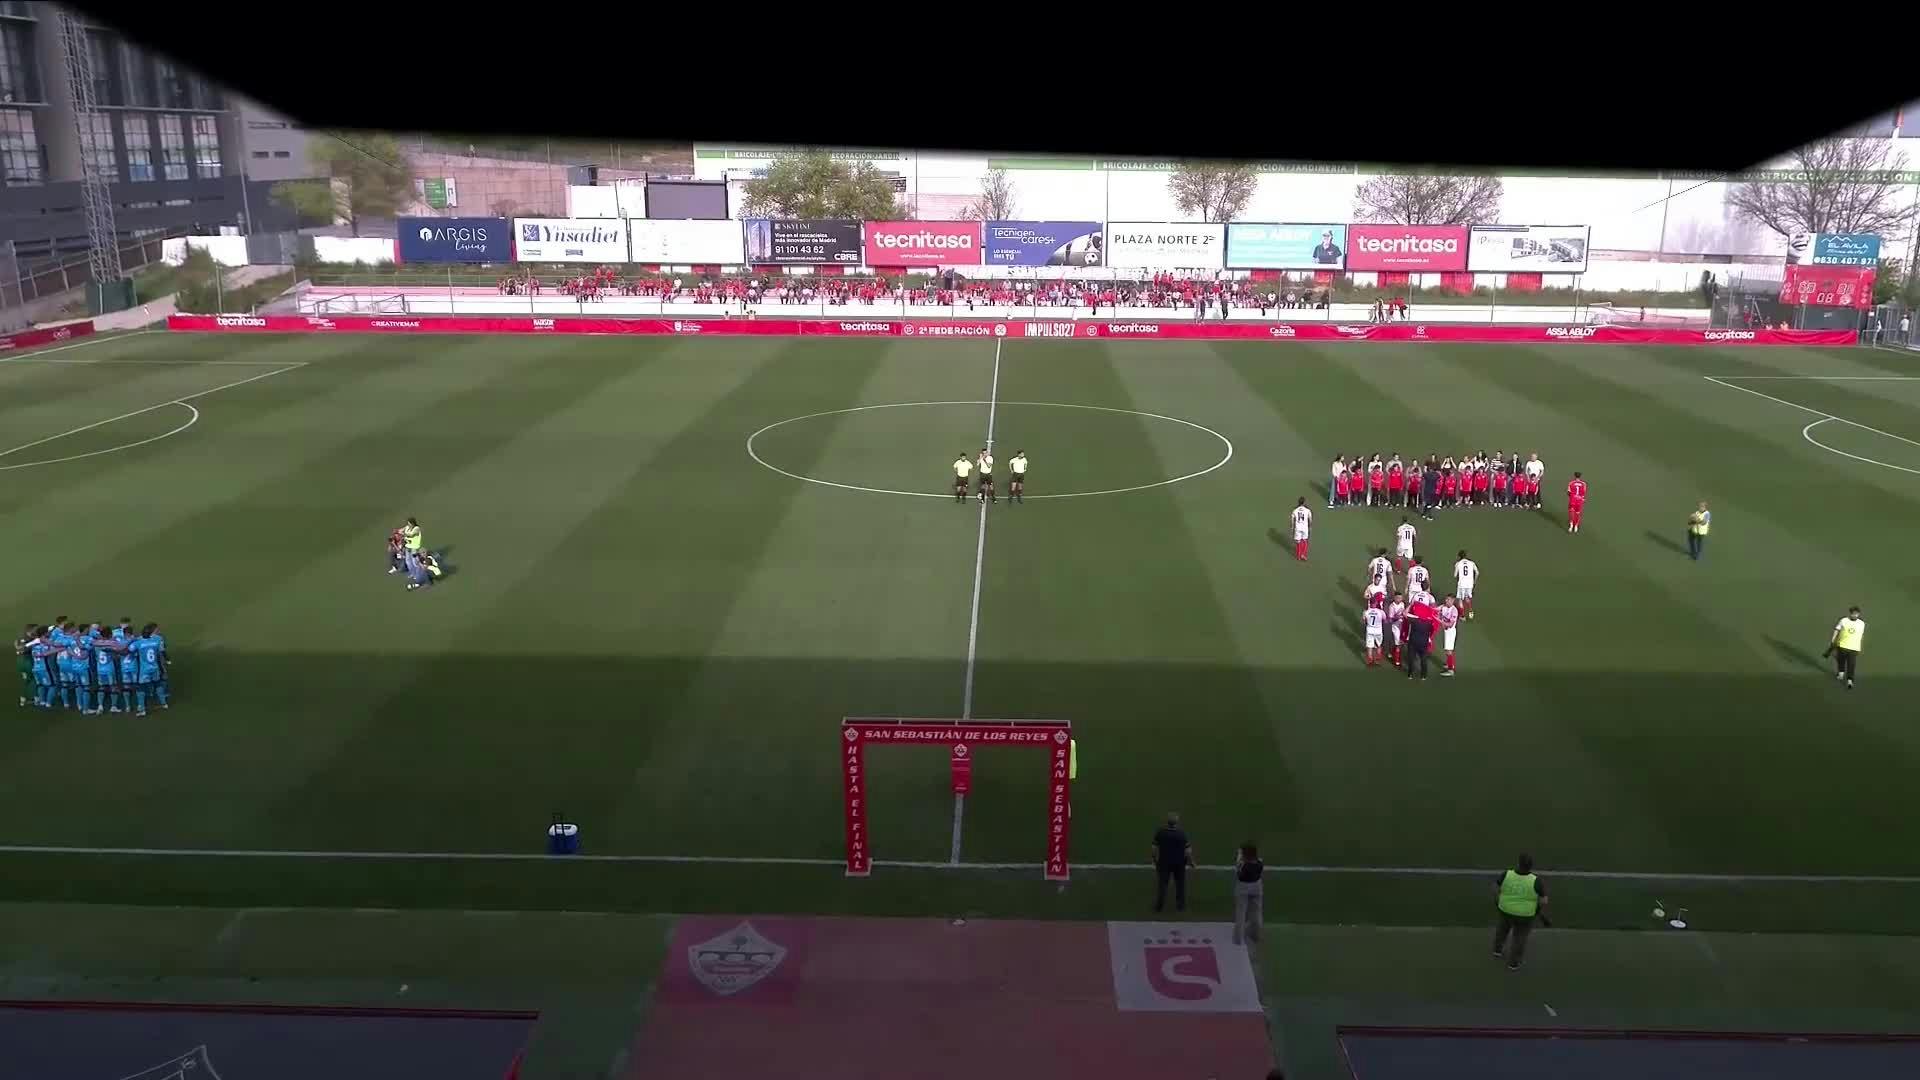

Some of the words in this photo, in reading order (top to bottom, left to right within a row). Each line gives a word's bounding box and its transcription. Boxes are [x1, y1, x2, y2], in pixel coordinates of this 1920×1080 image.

[434, 227, 488, 241] ARGIS
[873, 230, 973, 249] tecnitasa
[1114, 234, 1153, 245] PLAZA
[1157, 234, 1198, 246] NORTE
[775, 245, 784, 253] 91
[786, 245, 799, 253] 101
[801, 245, 812, 253] 43
[813, 245, 825, 253] 62
[1357, 233, 1458, 254] tecnitasa
[833, 253, 859, 261] CBRE
[216, 315, 266, 327] tecnitasa
[840, 320, 891, 332] tecnitasa
[1108, 321, 1160, 333] tecnitasa
[928, 324, 991, 336] FEDERACIÓN
[1545, 327, 1569, 336] ASSA
[1568, 327, 1597, 336] ABLOY
[1703, 328, 1756, 340] tecnitasa
[1405, 529, 1412, 540] 11
[1462, 565, 1469, 577] 6
[1370, 615, 1377, 626] 7
[99, 651, 108, 665] 5
[147, 648, 156, 663] 6
[864, 729, 892, 739] SAN
[892, 730, 963, 740] SEBASTIÁN
[964, 731, 982, 740] DE
[983, 732, 1008, 741] LOS
[1009, 732, 1050, 742] REYES
[847, 745, 860, 793] HASTA
[1055, 749, 1067, 779] SAN
[851, 799, 861, 817] EL
[851, 823, 864, 869] FINAL
